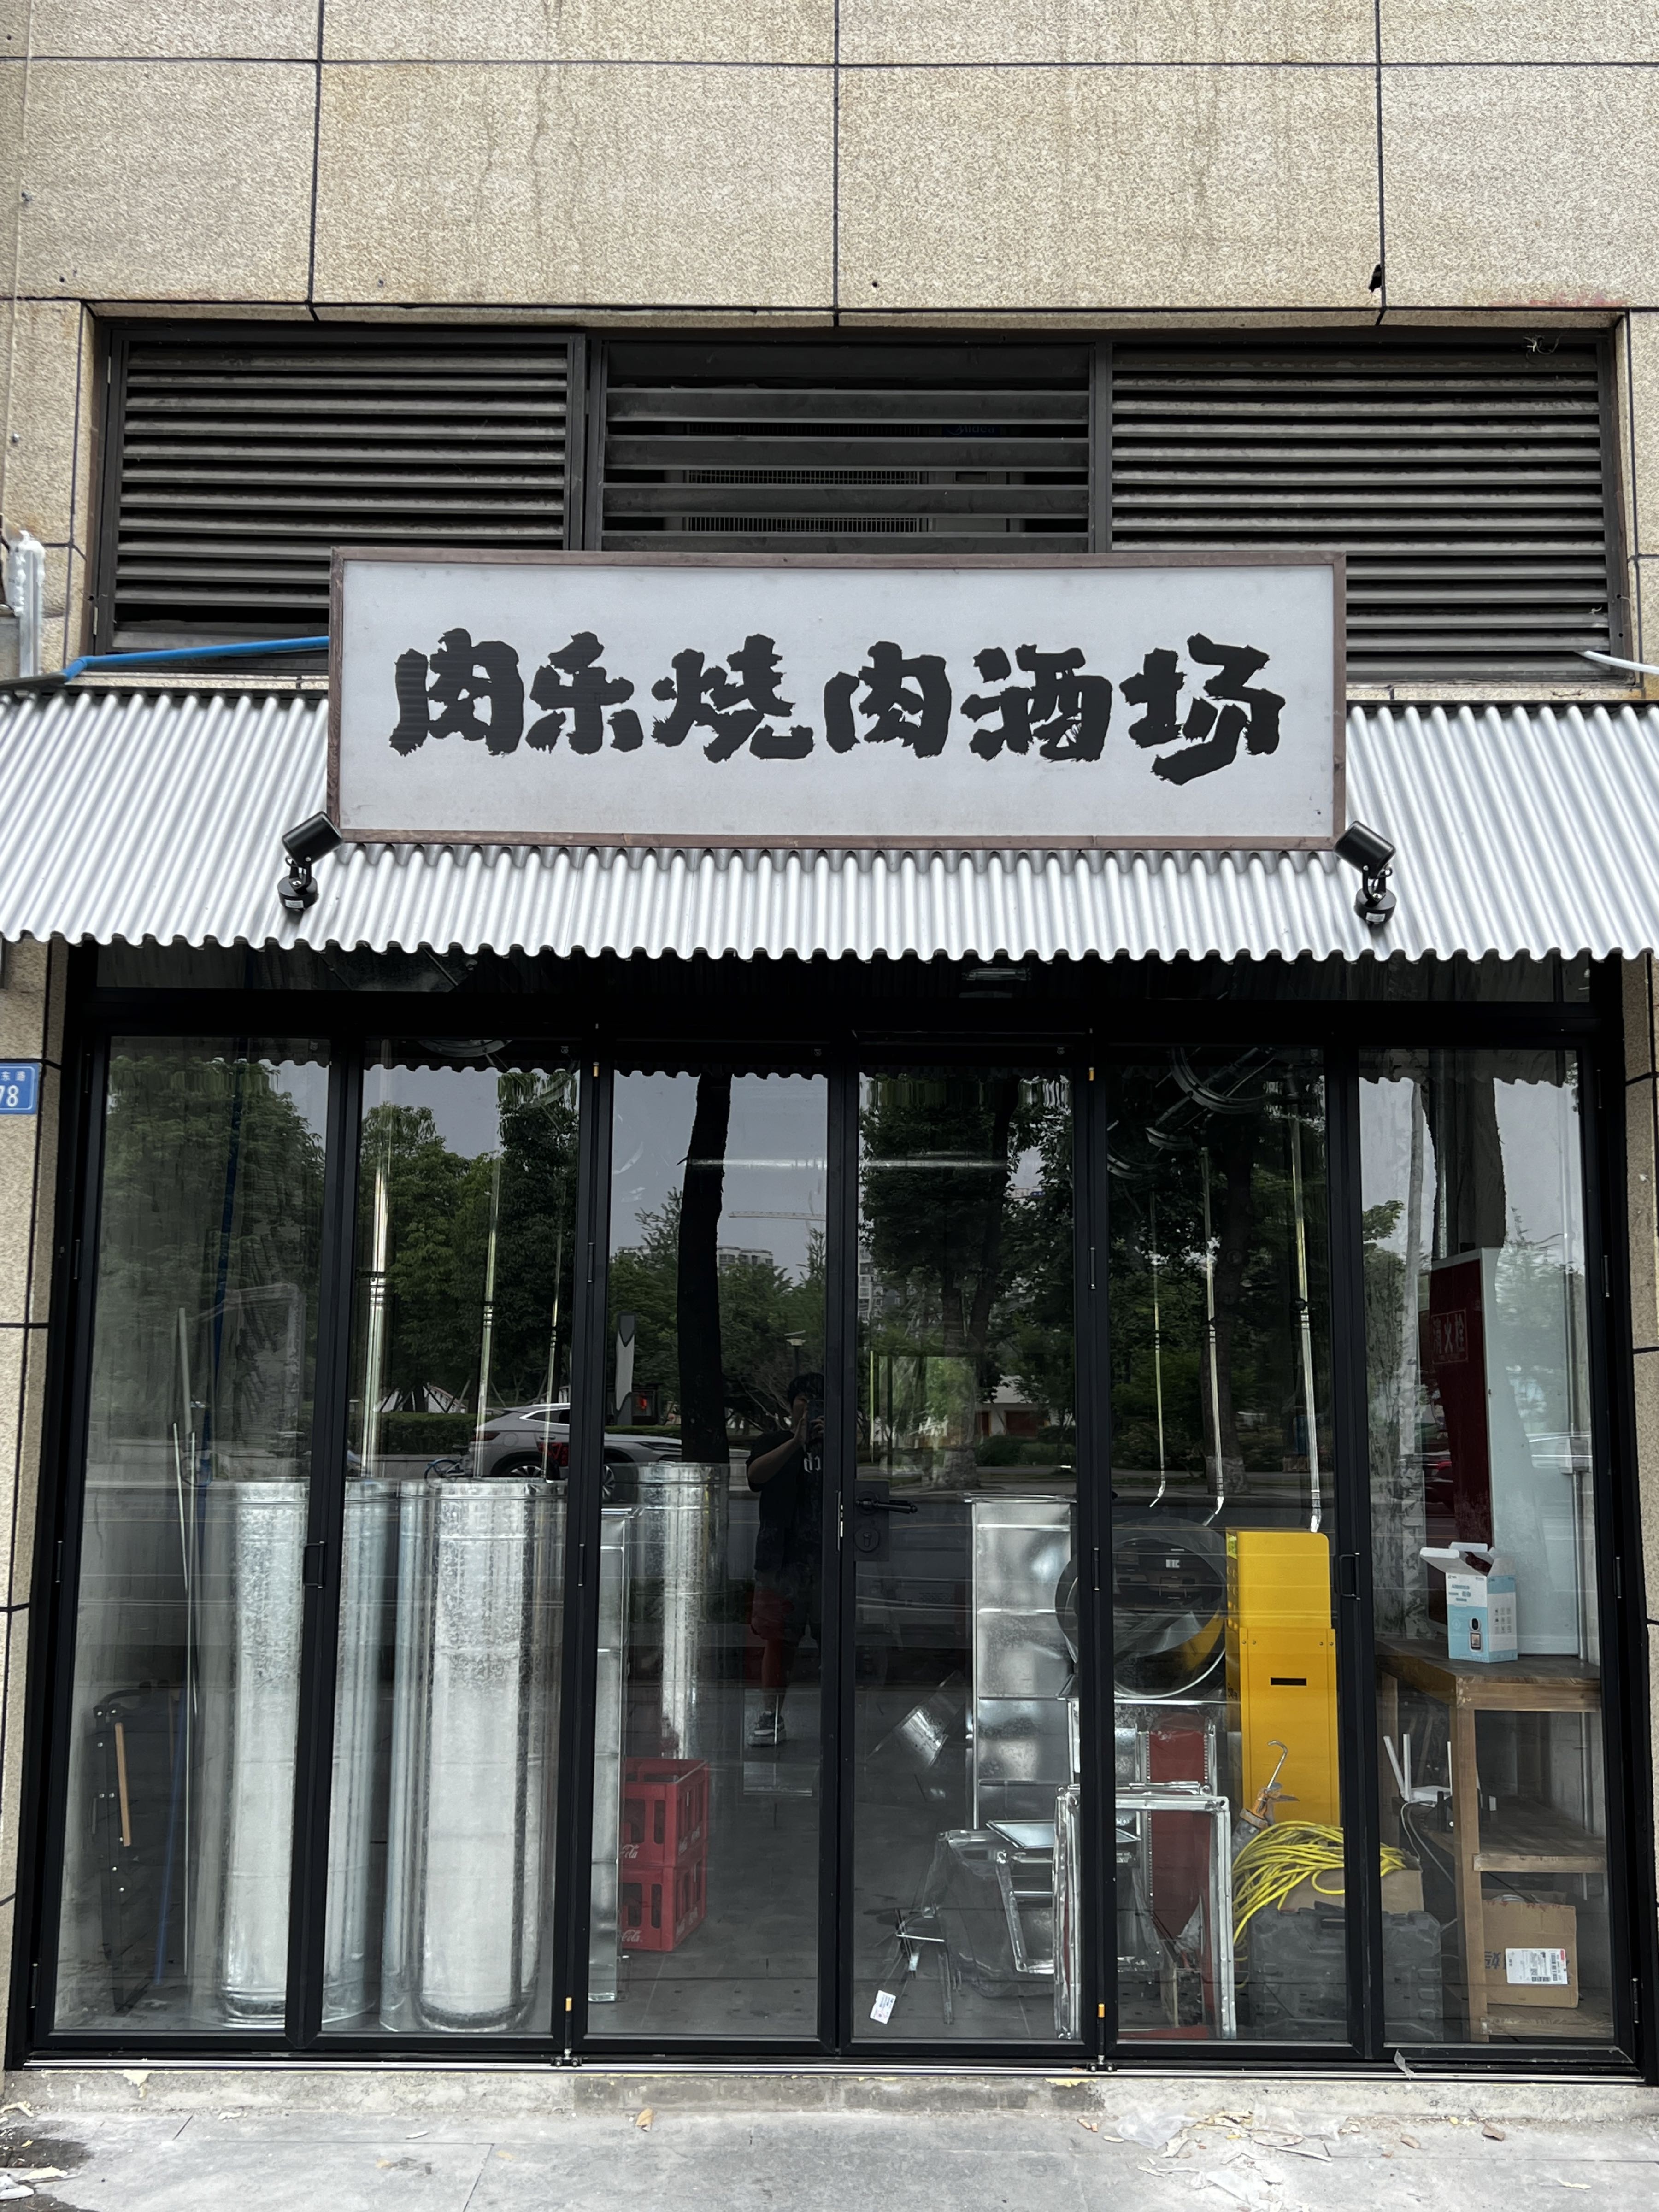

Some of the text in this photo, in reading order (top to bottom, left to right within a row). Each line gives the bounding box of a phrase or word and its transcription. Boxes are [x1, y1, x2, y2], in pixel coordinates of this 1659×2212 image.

[390, 629, 1285, 785] 肉乐烧肉酒场
[1432, 1313, 1465, 1354] 消火栓
